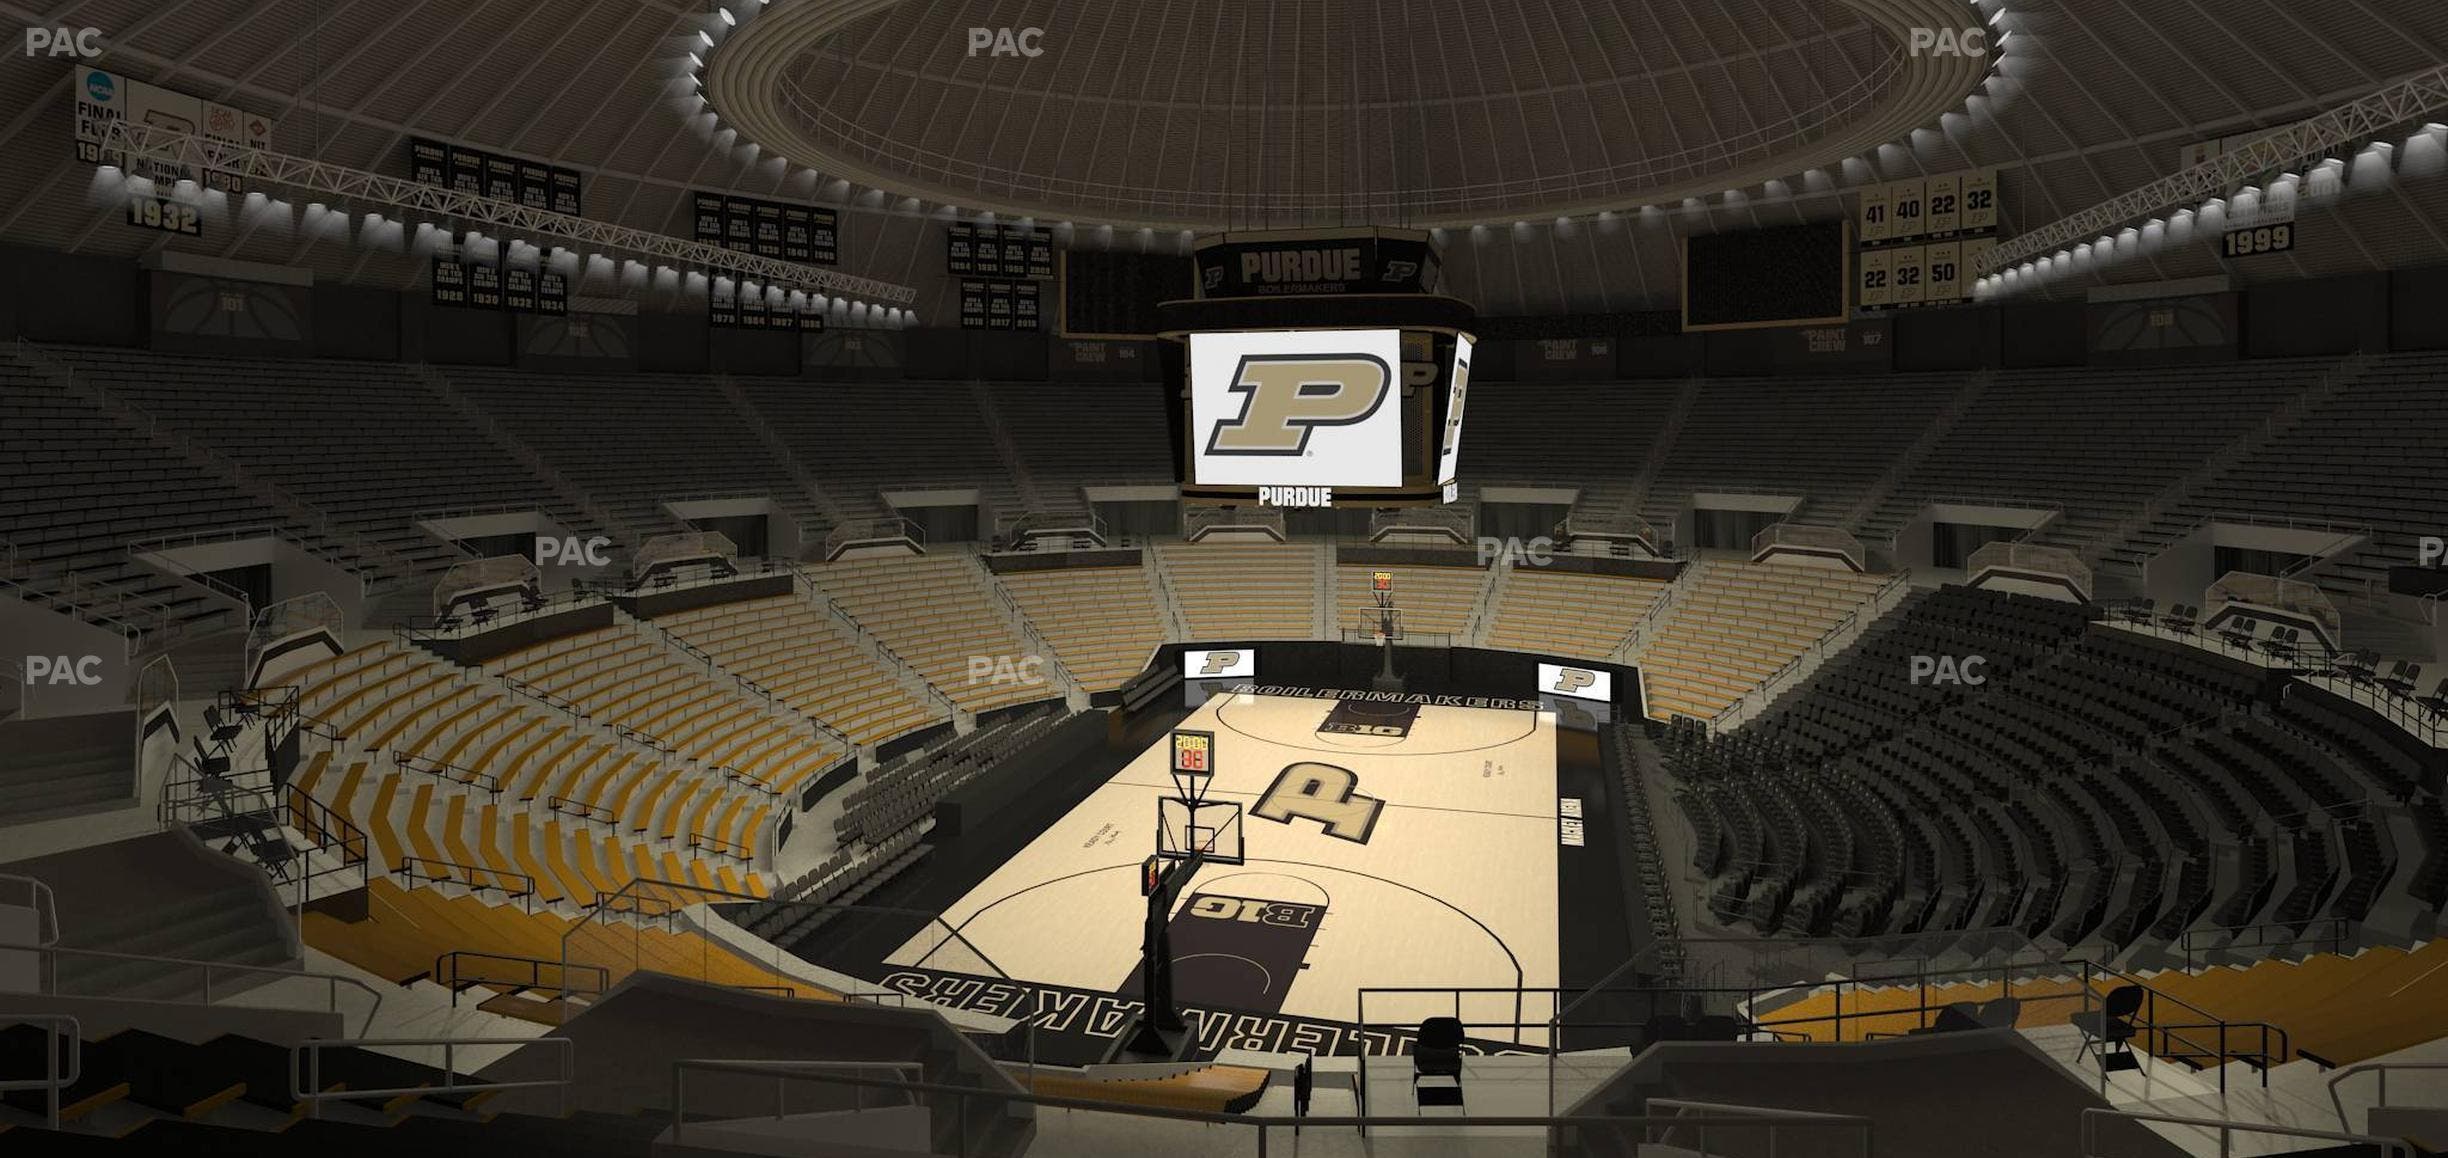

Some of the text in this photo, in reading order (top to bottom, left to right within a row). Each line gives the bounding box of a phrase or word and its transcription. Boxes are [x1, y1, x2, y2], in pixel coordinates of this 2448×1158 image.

[1896, 200, 1920, 219] 40
[1931, 195, 1955, 215] 22
[1967, 190, 1992, 210] 32
[130, 198, 199, 234] 1932
[1866, 205, 1884, 224] 41
[2225, 226, 2290, 256] 1999
[1241, 249, 1361, 284] PURDUE
[1897, 266, 1920, 285] 32
[1931, 263, 1955, 282] 50
[1865, 270, 1886, 289] 22
[1204, 353, 1392, 456] P
[1258, 487, 1332, 507] PURDUE
[1200, 652, 1240, 673] P
[1555, 668, 1596, 694] P
[1231, 684, 1544, 711] BOILERMAKERS
